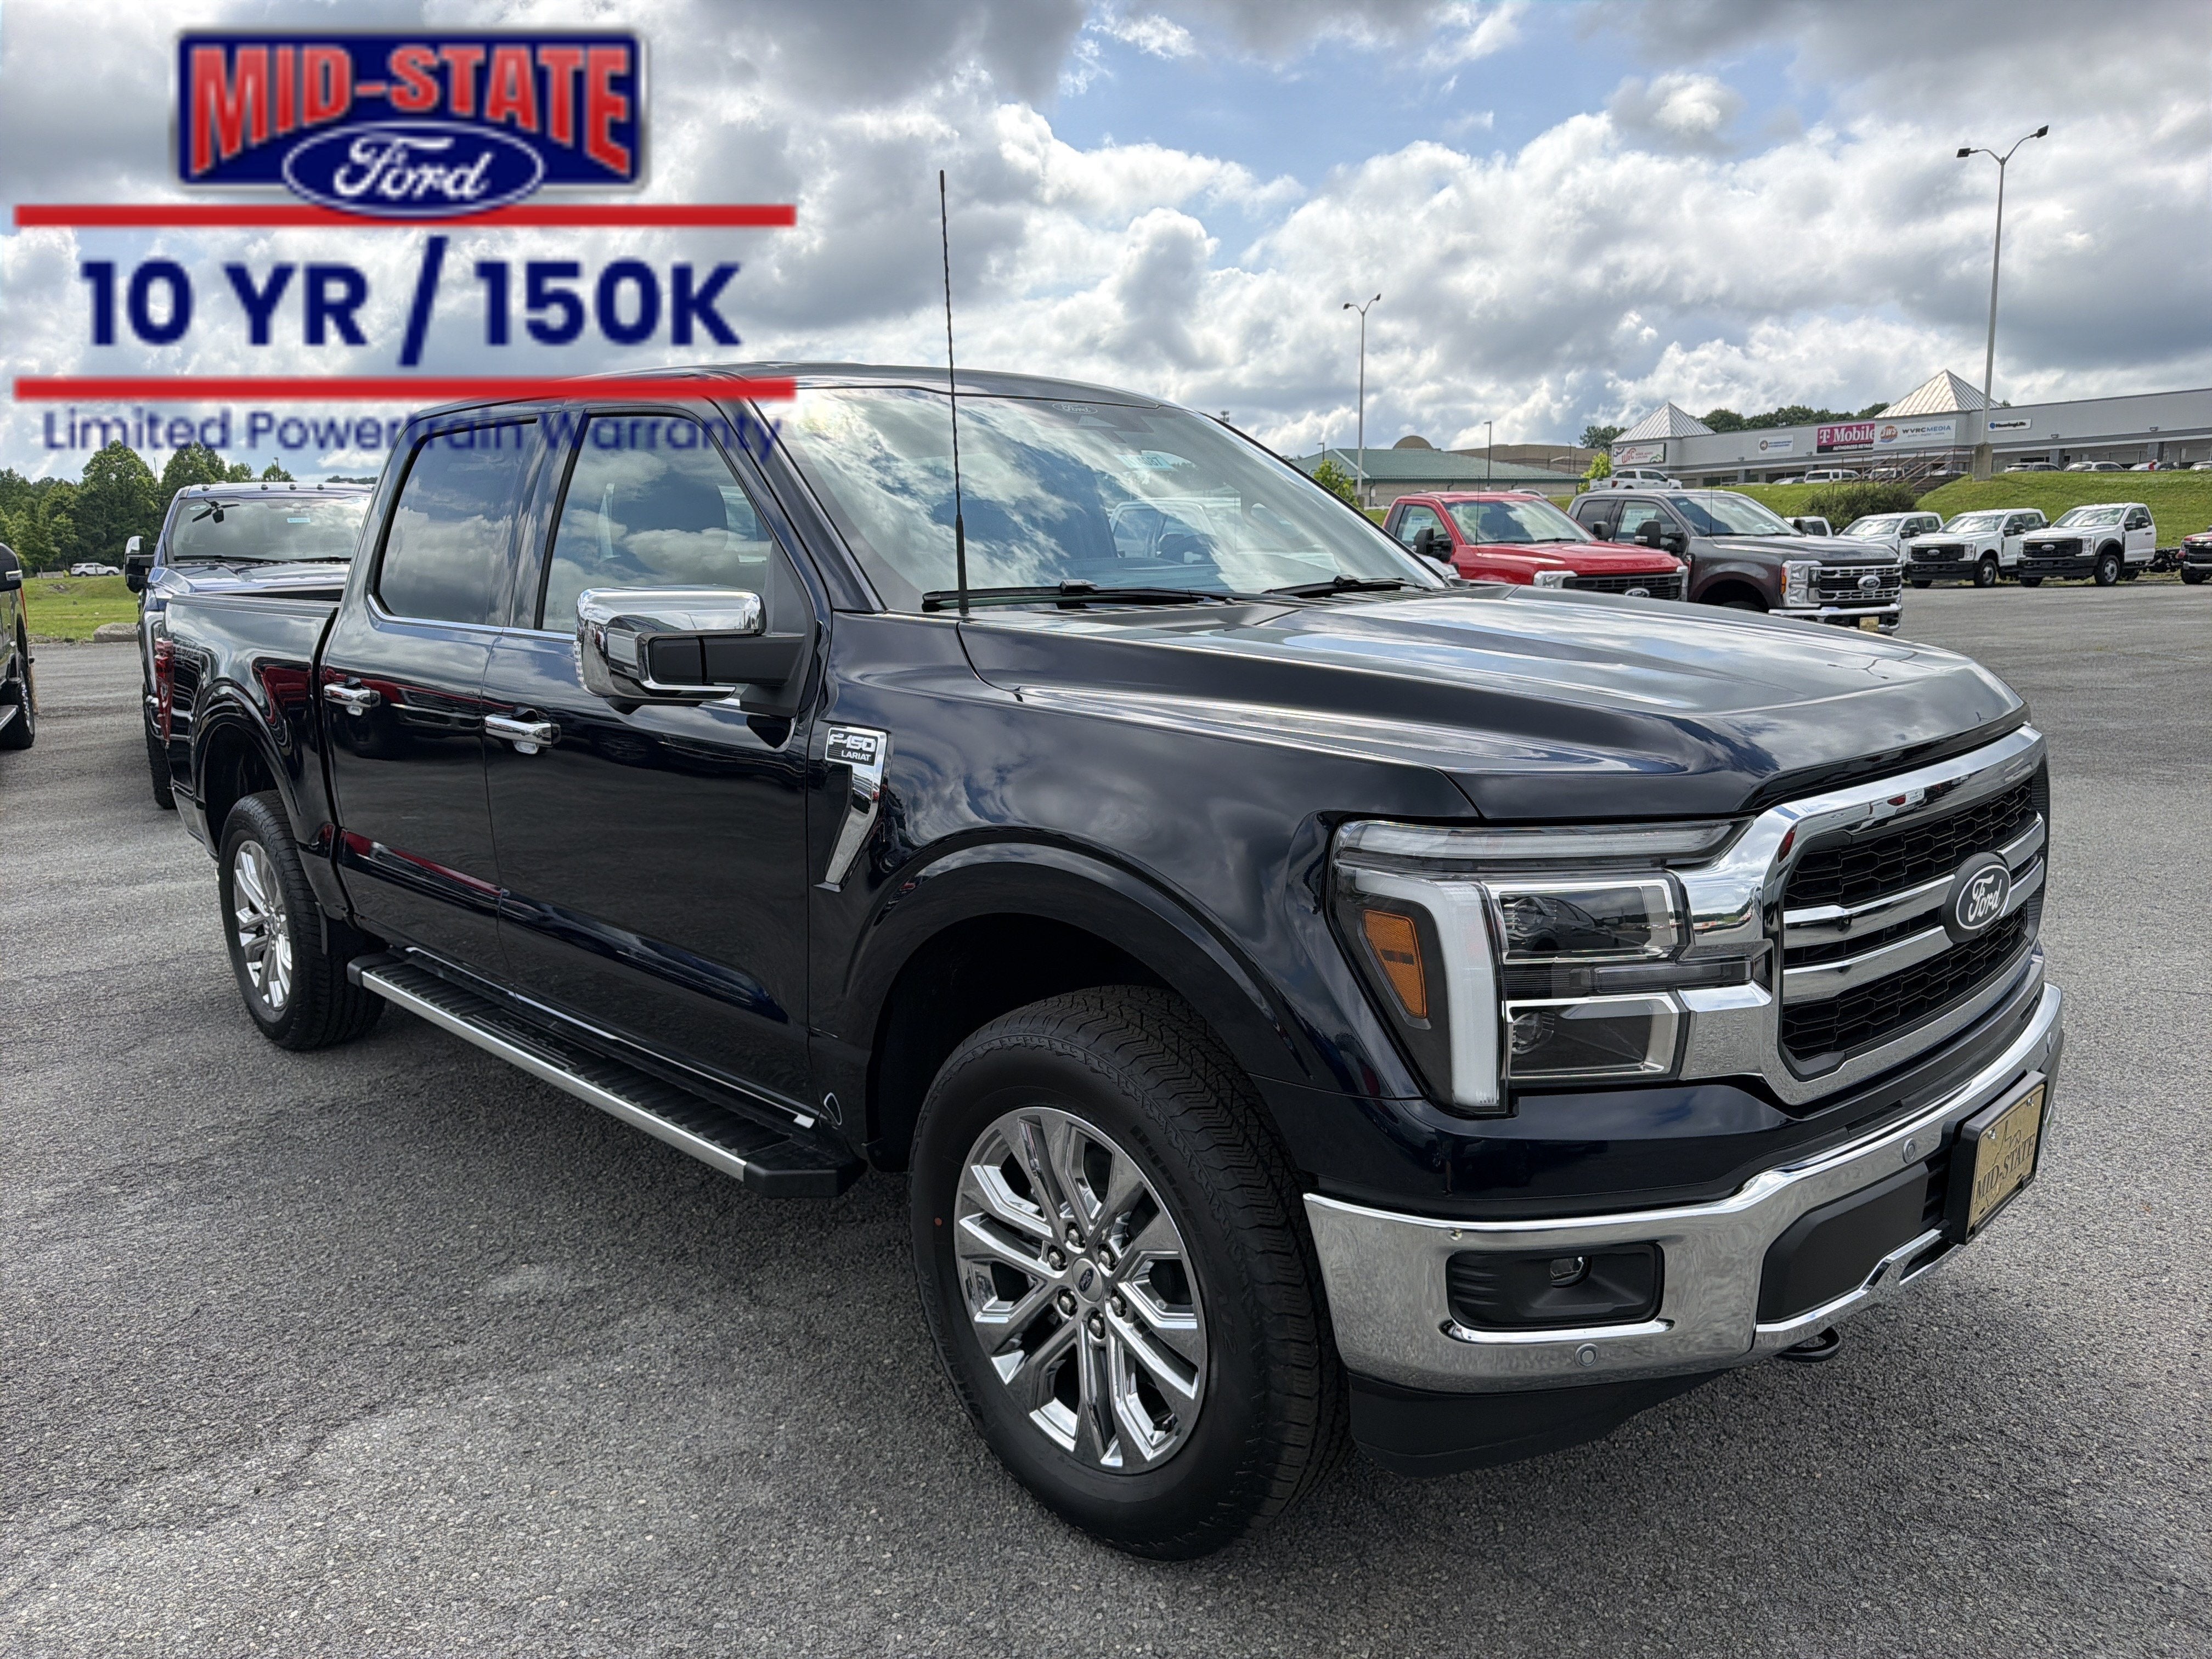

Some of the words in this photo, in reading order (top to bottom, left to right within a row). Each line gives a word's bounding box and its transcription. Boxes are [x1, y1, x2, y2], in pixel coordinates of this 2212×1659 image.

[1061, 404, 1091, 413] Ford
[829, 733, 876, 752] F-150
[841, 749, 872, 761] LARIAT
[1968, 874, 2002, 922] Ford
[1976, 1134, 2035, 1200] MID-STATE
